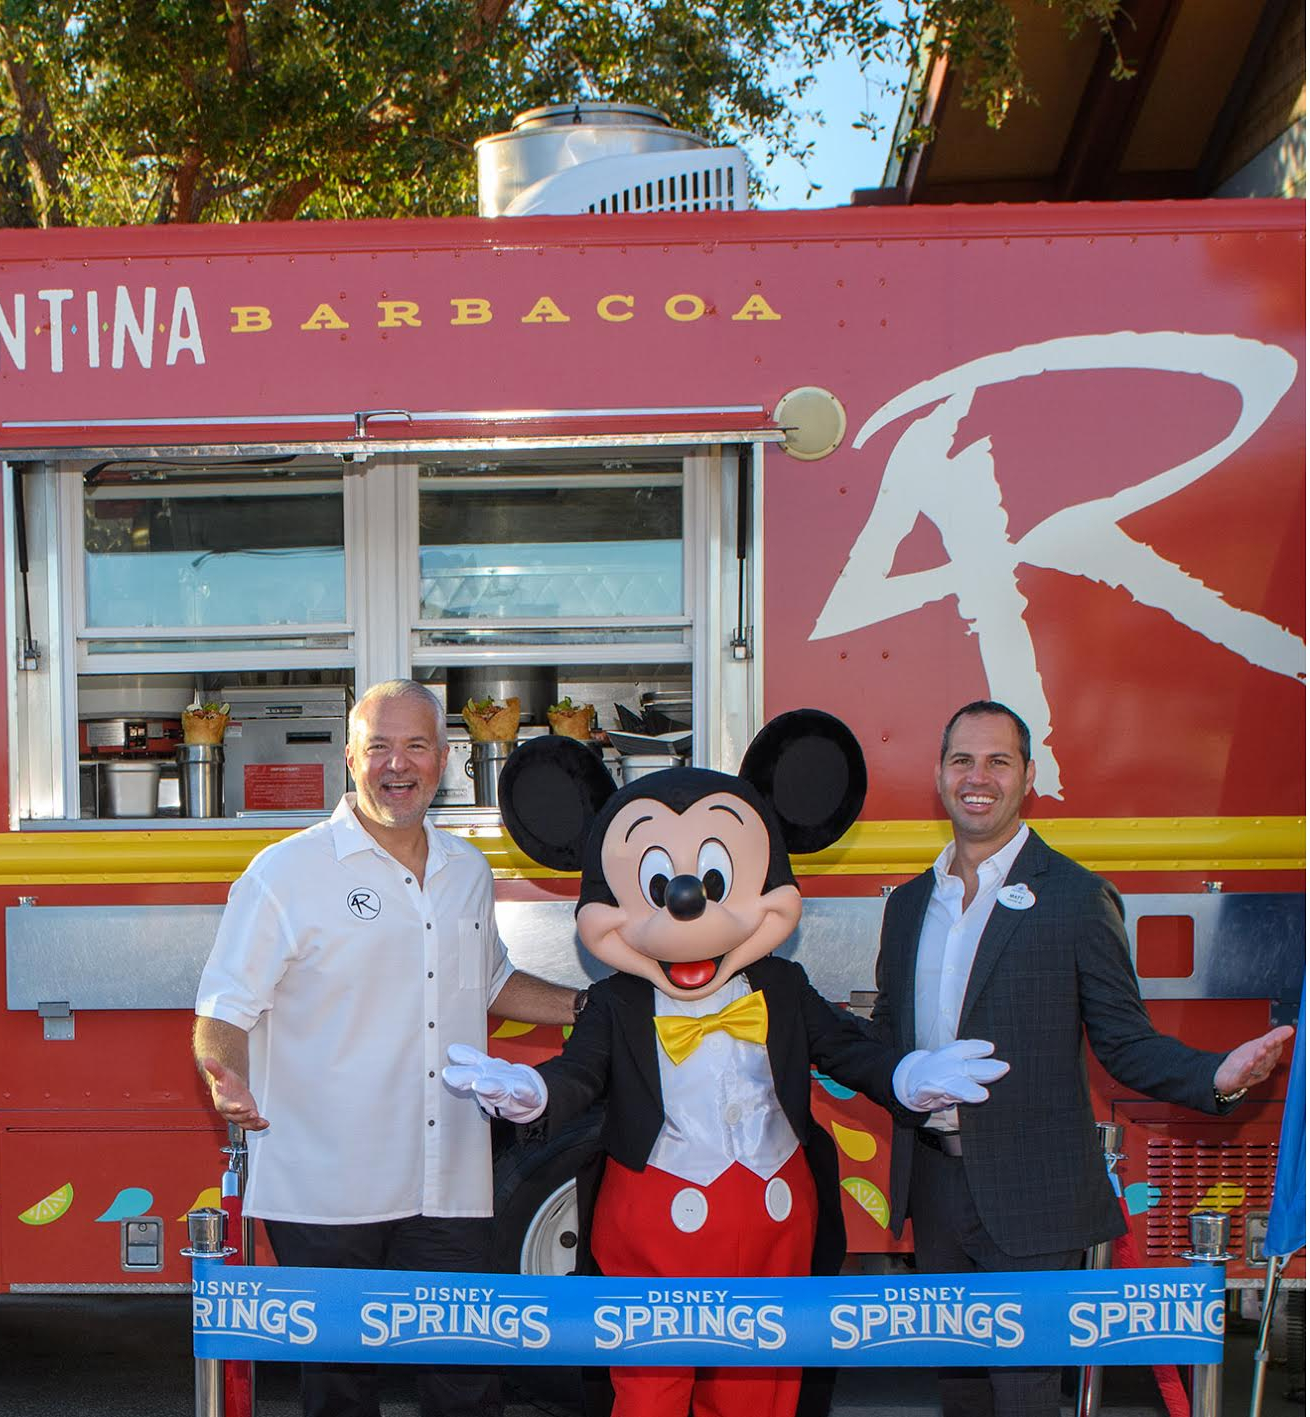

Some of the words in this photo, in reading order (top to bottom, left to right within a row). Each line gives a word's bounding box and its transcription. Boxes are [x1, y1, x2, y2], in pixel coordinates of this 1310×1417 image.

[230, 294, 781, 334] BARBACOA
[415, 1287, 494, 1303] DISNEY
[648, 1290, 728, 1304] DISNEY
[884, 1287, 966, 1301] DISNEY
[1123, 1283, 1207, 1299] DISNEY
[361, 1302, 551, 1349] SPRINGS
[594, 1305, 786, 1349] SPRINGS
[830, 1302, 1025, 1349] SPRINGS
